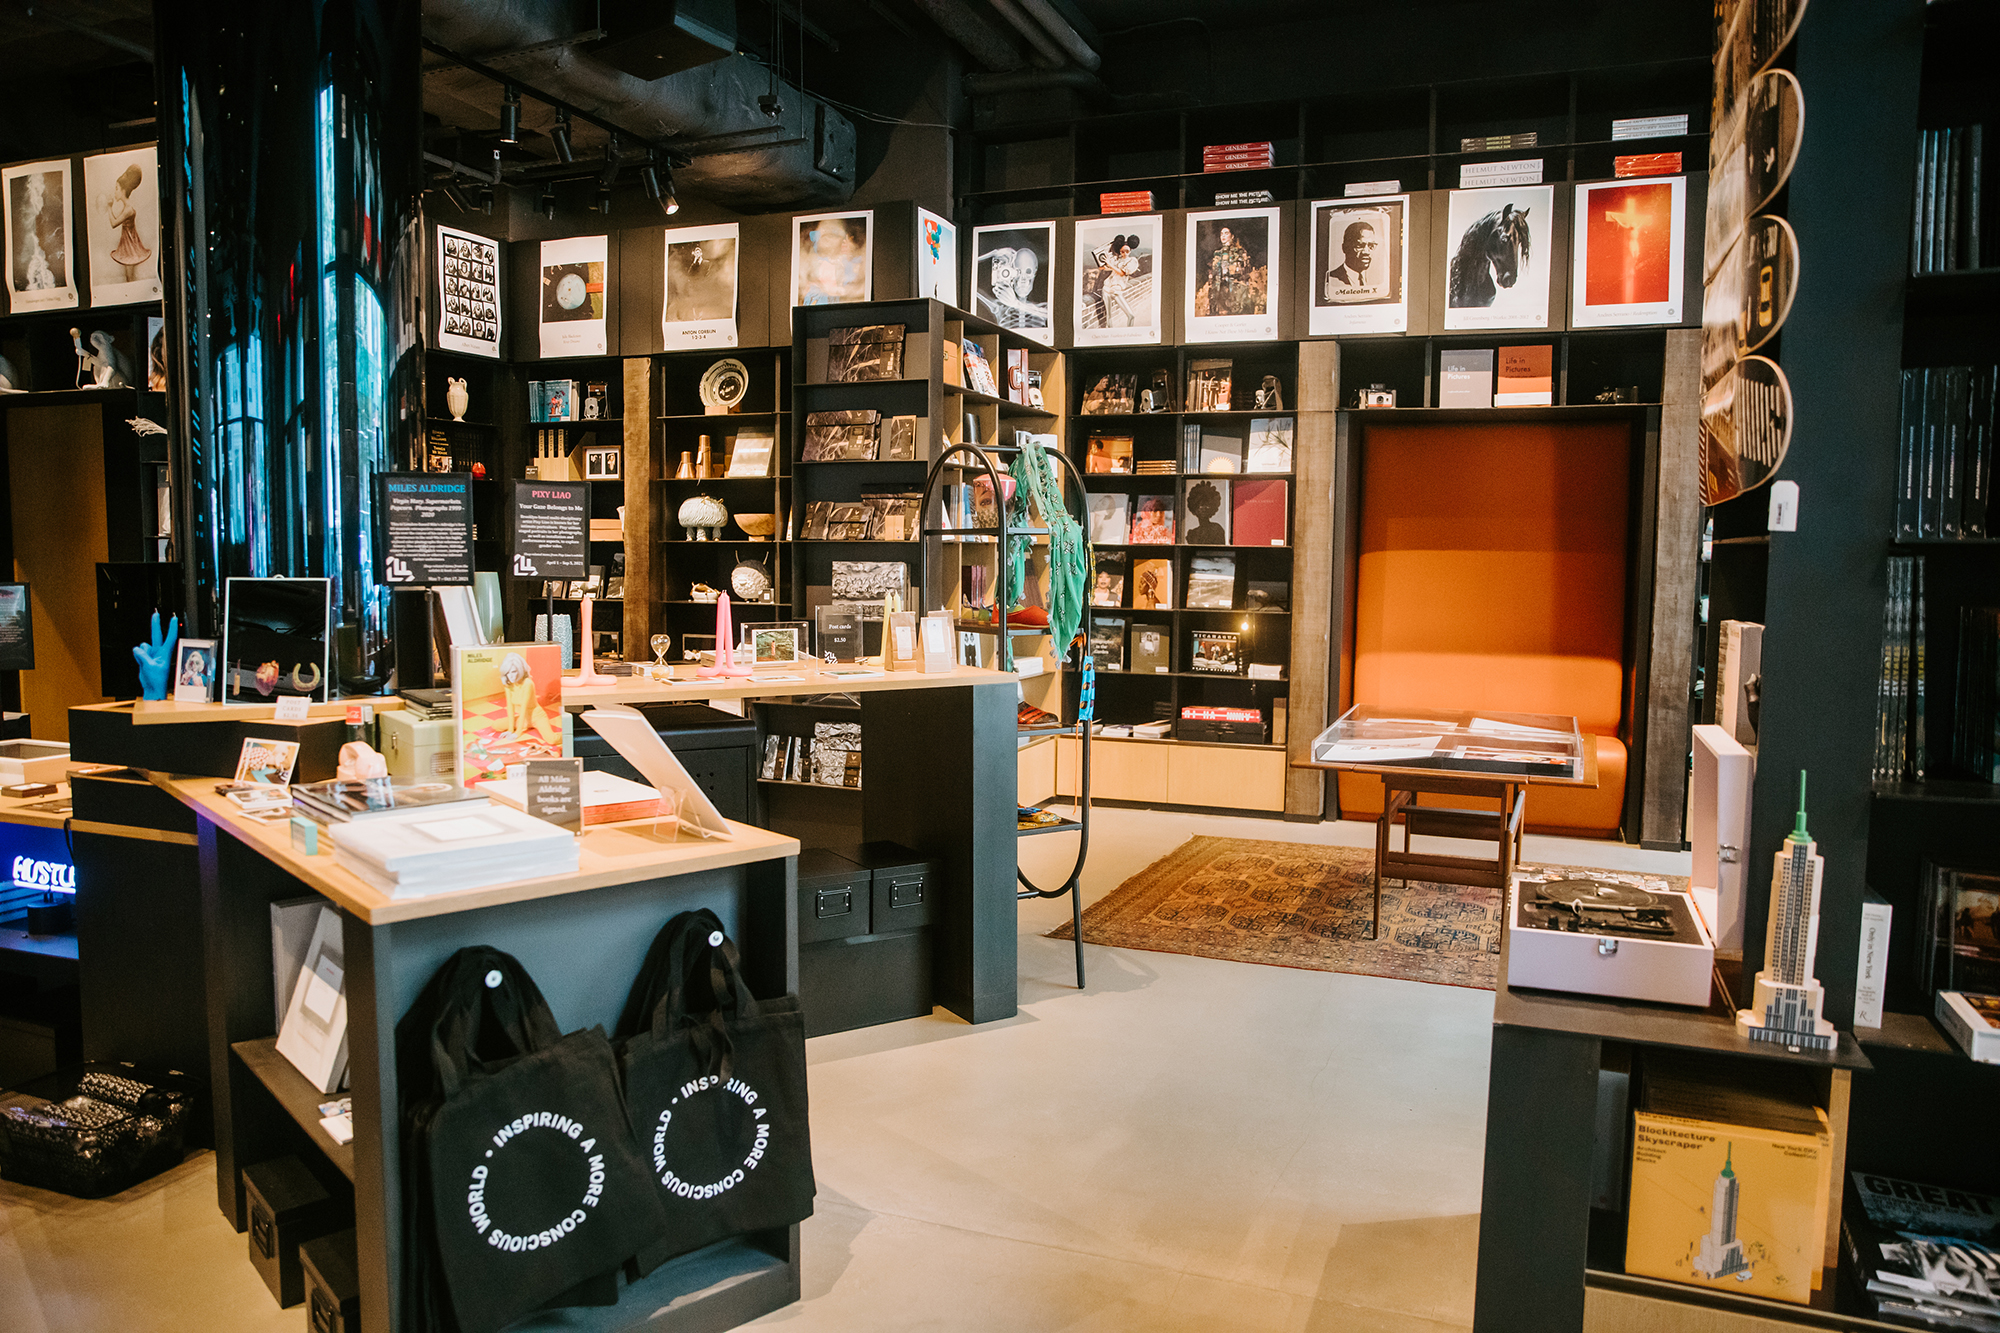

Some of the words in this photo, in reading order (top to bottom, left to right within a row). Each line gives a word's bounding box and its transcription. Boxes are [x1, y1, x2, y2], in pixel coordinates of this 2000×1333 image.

[1466, 166, 1497, 174] HELMUT
[1500, 163, 1535, 171] NEWTON
[1465, 178, 1496, 186] HELMUT
[1499, 175, 1535, 183] NEWTON
[388, 484, 417, 492] MILES
[419, 484, 466, 493] ALDRIDGE
[532, 490, 550, 498] PIXY
[552, 491, 571, 499] LIAO
[538, 786, 570, 794] Aldridge
[542, 805, 567, 814] signed.
[1867, 927, 1876, 941] Only
[1866, 951, 1874, 963] New
[680, 1075, 758, 1105] INSPRING
[752, 1108, 767, 1120] A
[492, 1111, 584, 1148] INSPIRING
[1639, 1125, 1715, 1142] Blockitecture
[580, 1137, 596, 1153] A
[653, 1109, 672, 1173] WORLD
[743, 1124, 770, 1170] MORE
[1638, 1135, 1702, 1150] Skyscraper
[1637, 1151, 1661, 1159] Building
[1784, 1151, 1817, 1160] Collection
[582, 1154, 605, 1207] MORE
[661, 1169, 744, 1200] CONSCIOUS
[467, 1165, 491, 1234] WORLD
[1864, 1175, 1994, 1215] GREAT
[488, 1209, 586, 1252] CONSCIOUS
